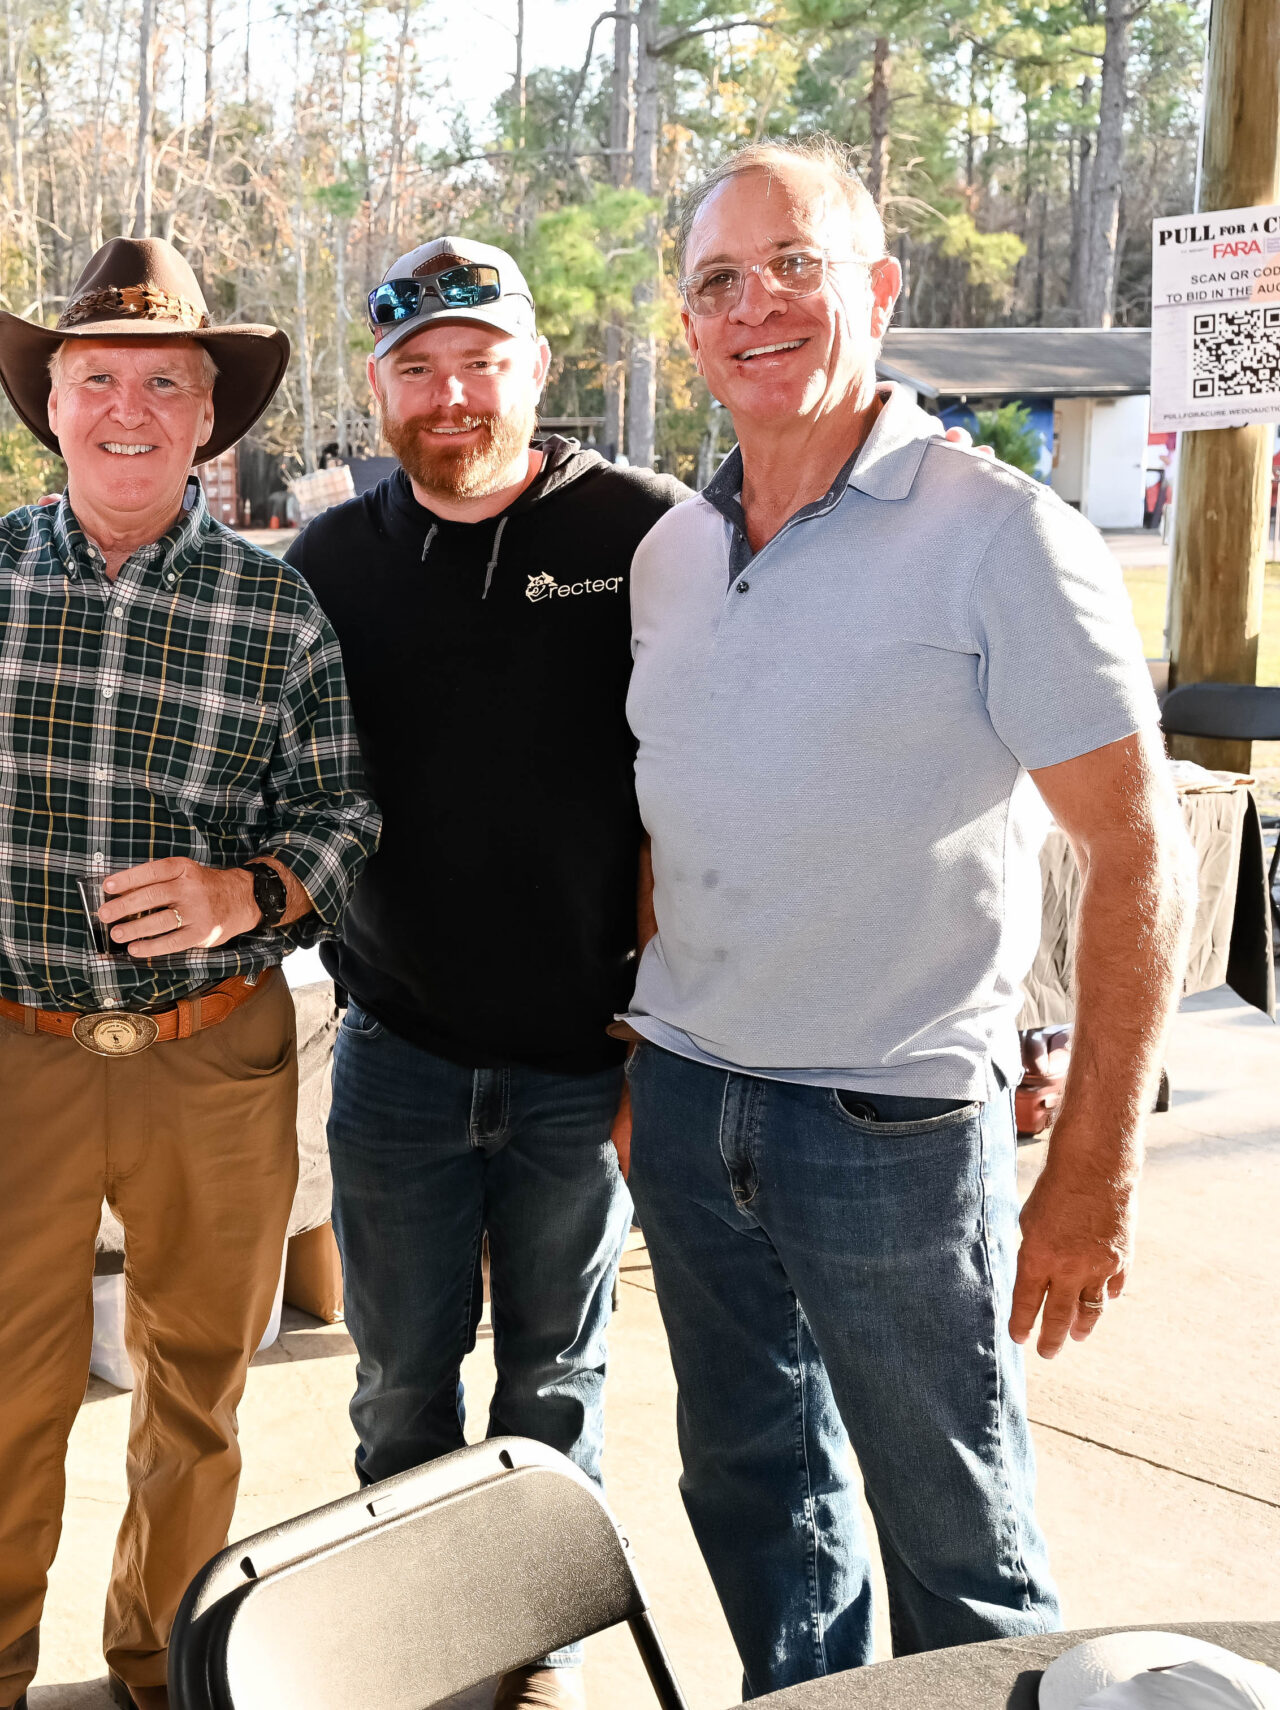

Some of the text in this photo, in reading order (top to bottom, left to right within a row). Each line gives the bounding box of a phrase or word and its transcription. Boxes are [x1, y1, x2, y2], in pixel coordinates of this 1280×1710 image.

[1159, 216, 1280, 246] PULL FOR A C
[1213, 240, 1261, 259] FARA
[1191, 272, 1226, 285] SCAN
[1230, 270, 1249, 280] QR
[1166, 293, 1183, 303] TO
[1186, 291, 1208, 301] BID
[1211, 289, 1224, 299] IN
[1228, 285, 1253, 297] THE
